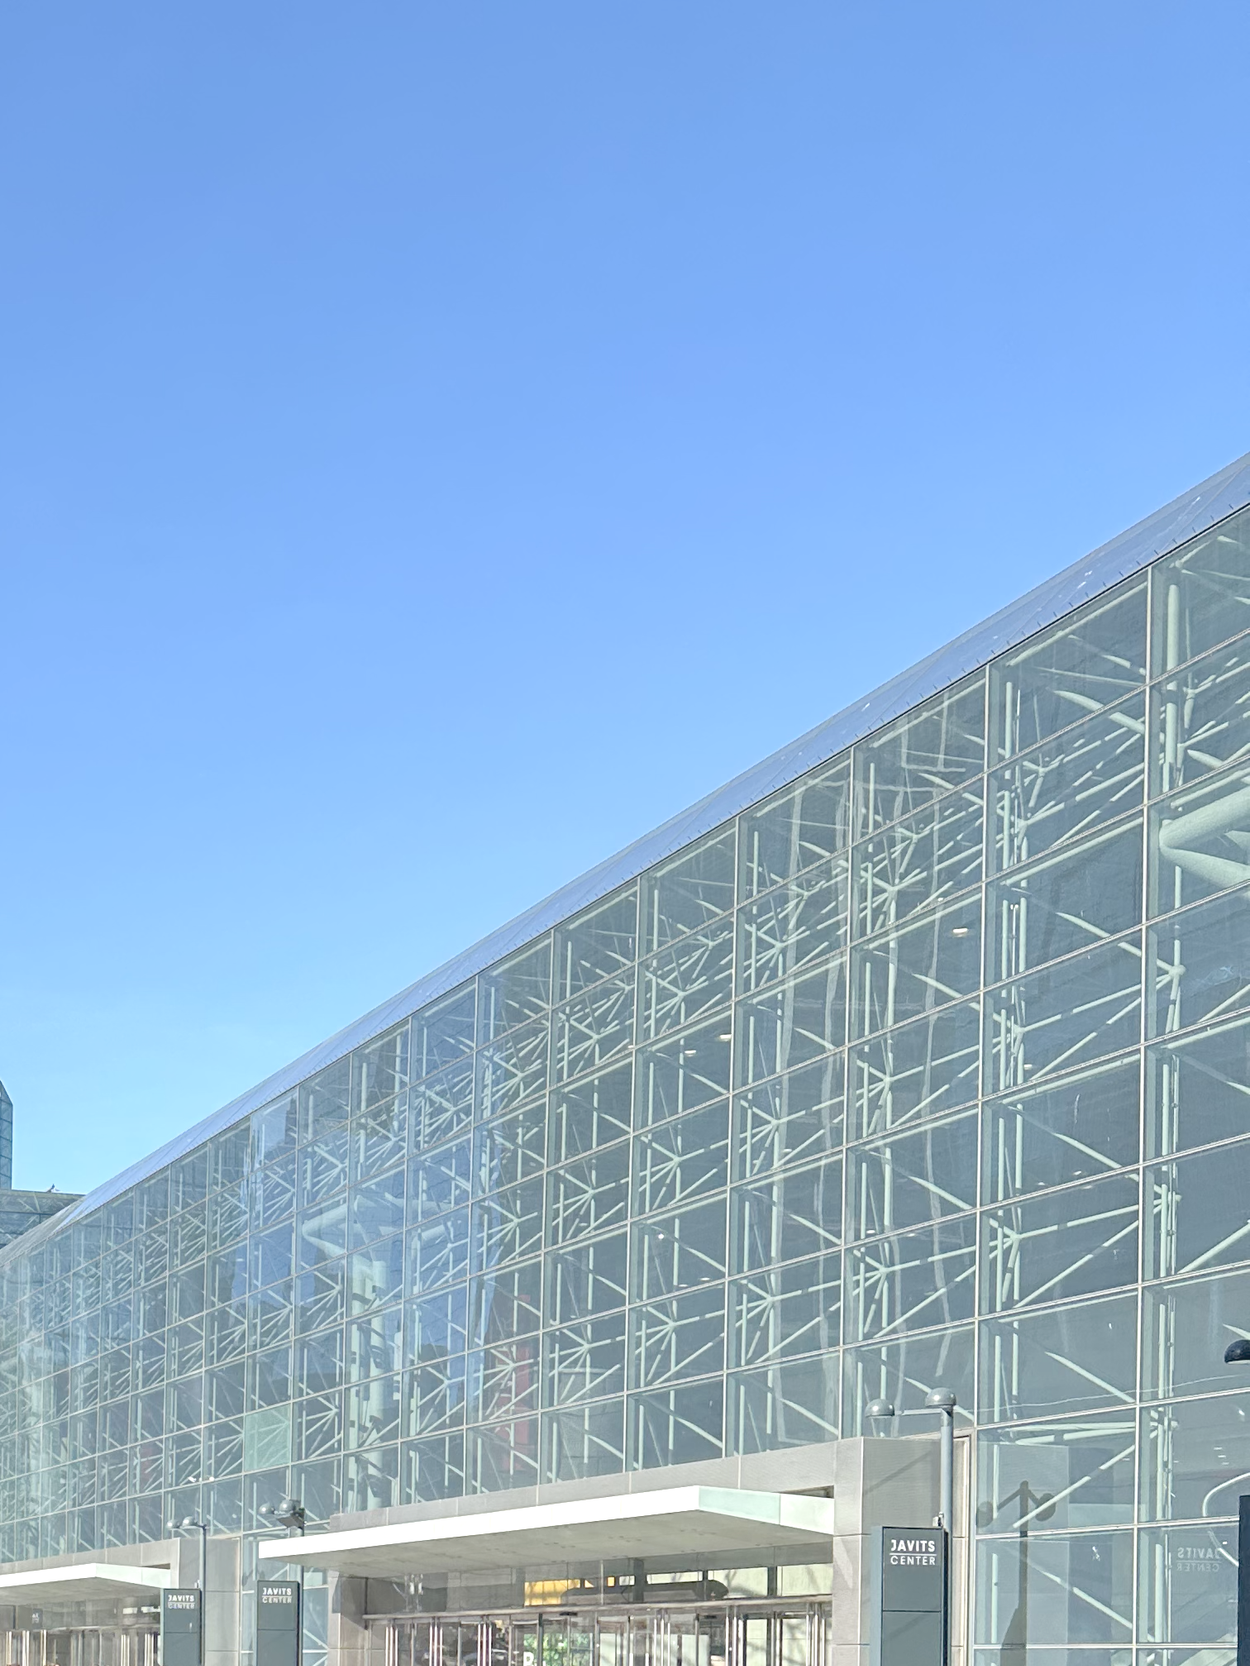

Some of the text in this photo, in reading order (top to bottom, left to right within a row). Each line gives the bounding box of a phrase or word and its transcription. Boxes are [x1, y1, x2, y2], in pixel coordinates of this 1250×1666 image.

[890, 1539, 936, 1552] JAVITS
[890, 1555, 936, 1566] CENTER
[262, 1587, 292, 1596] JAVITS
[167, 1594, 195, 1602] JAVITS
